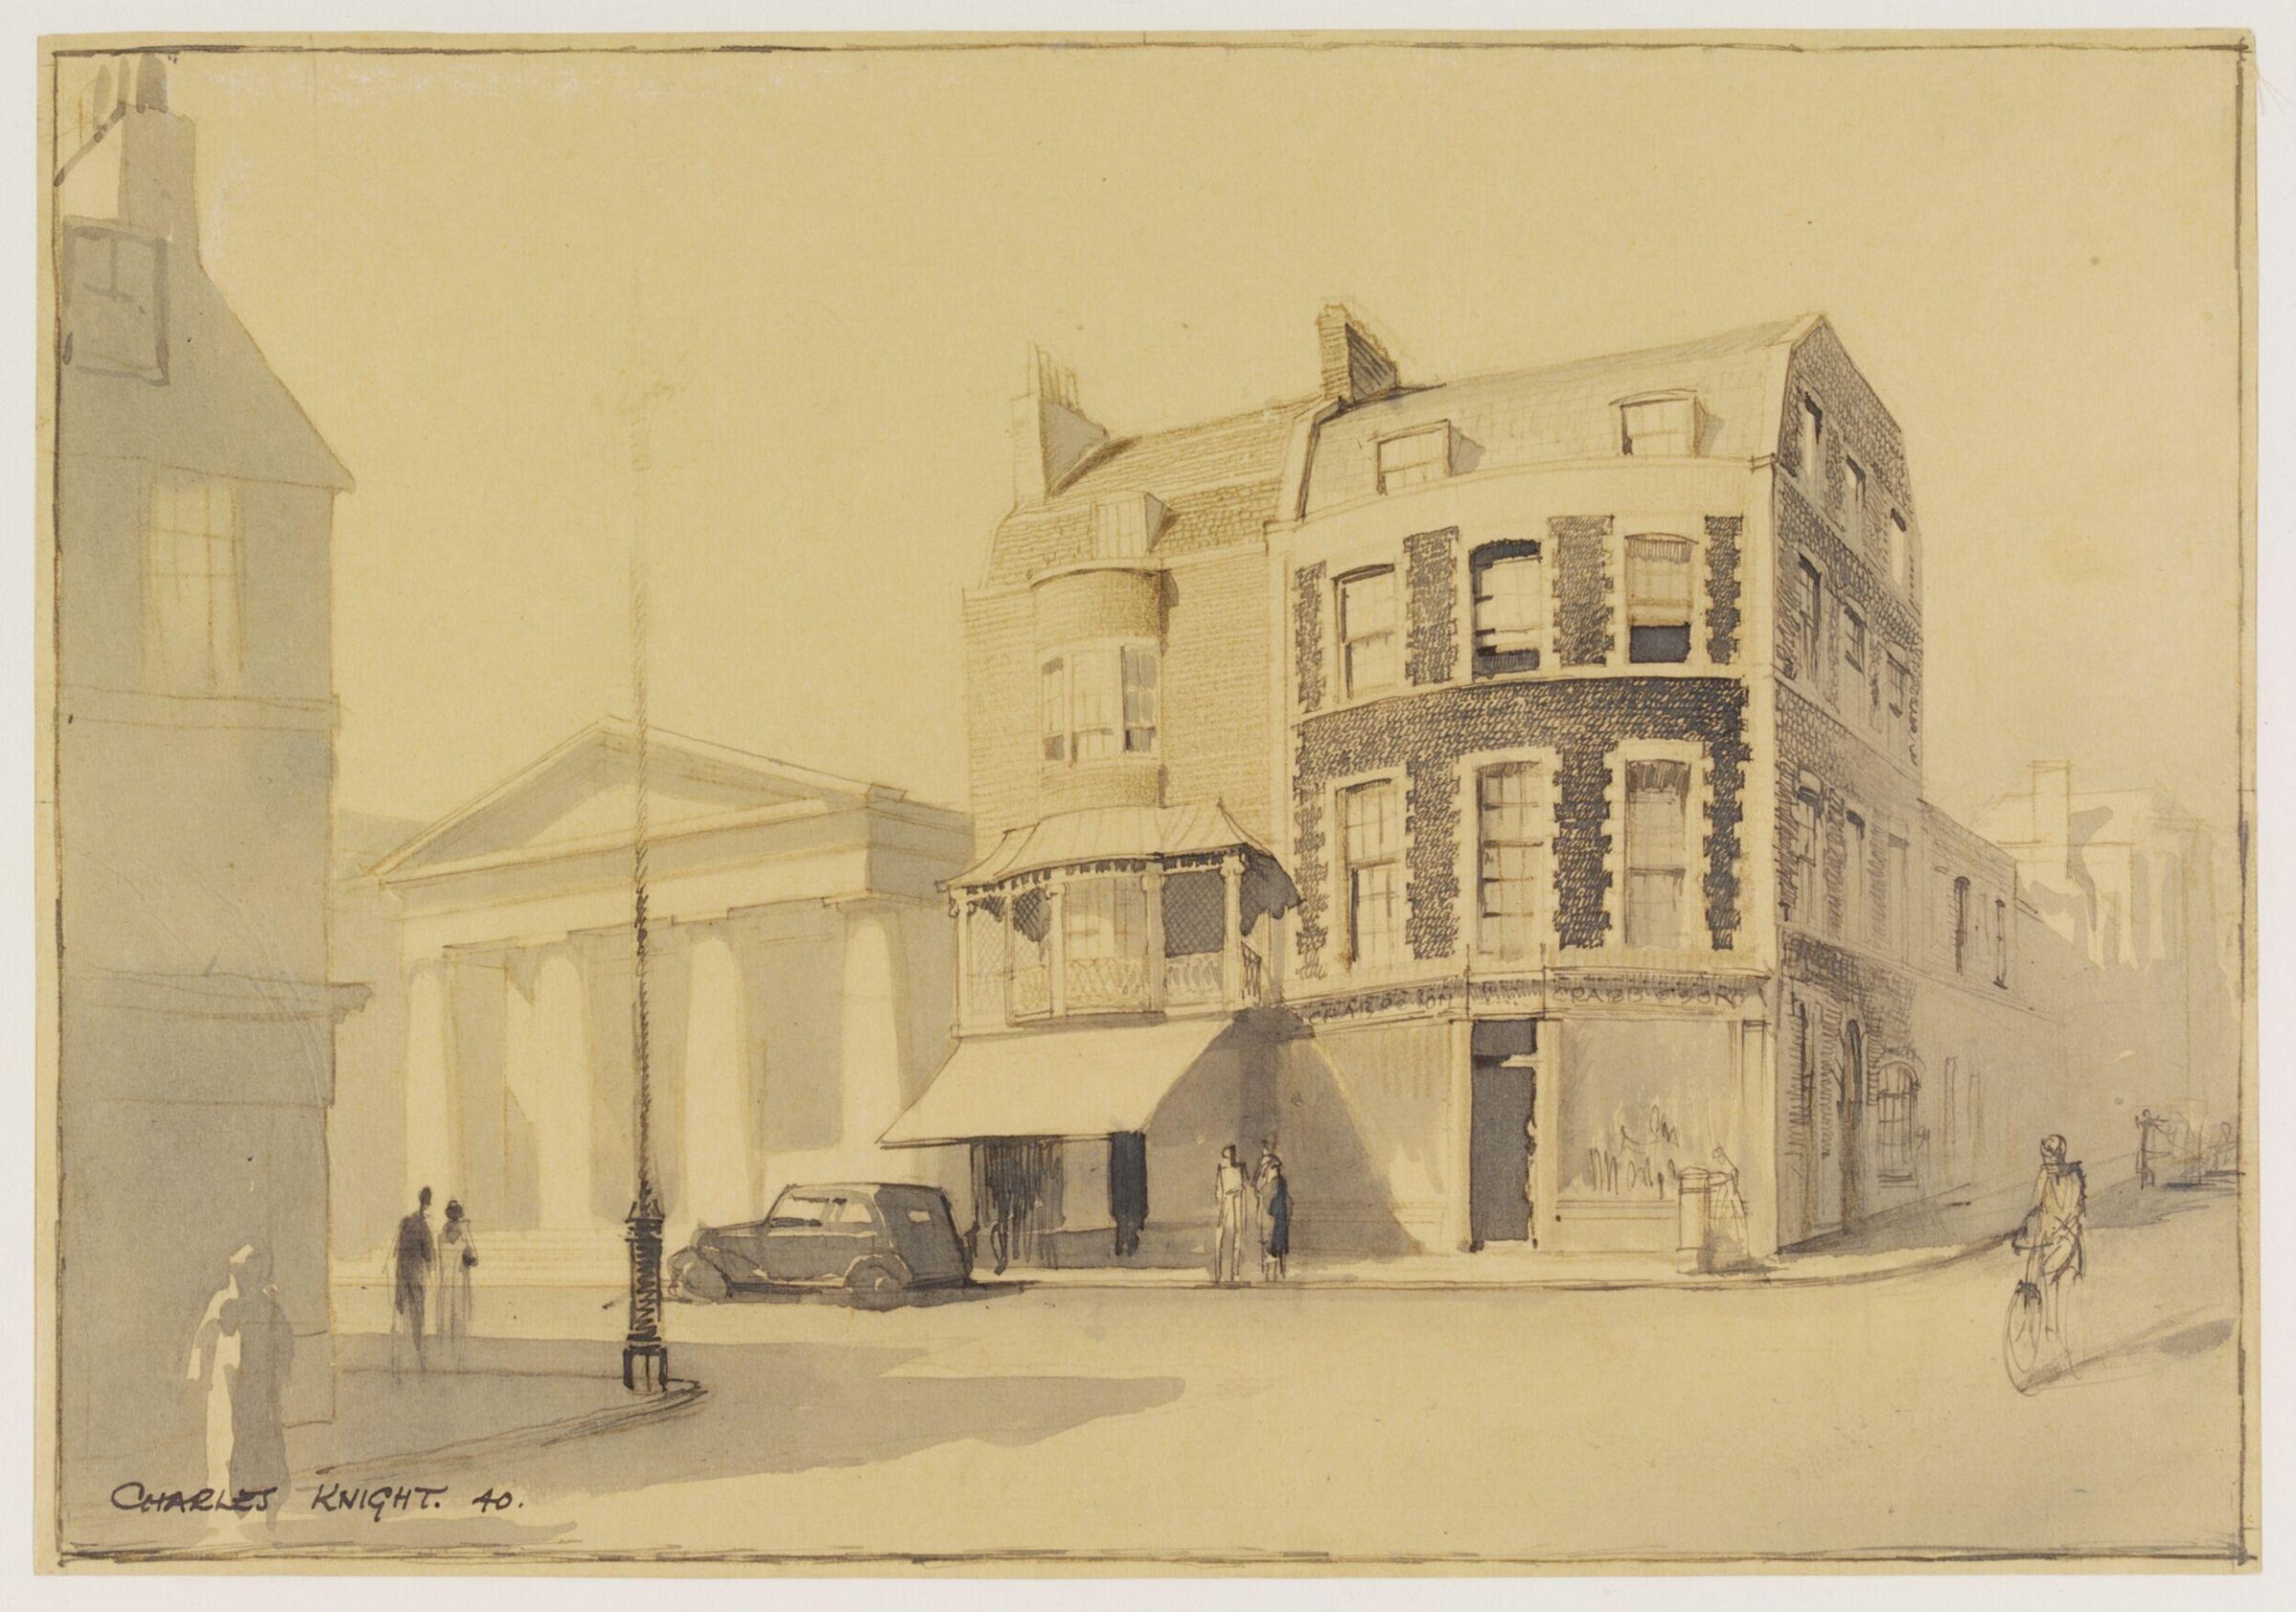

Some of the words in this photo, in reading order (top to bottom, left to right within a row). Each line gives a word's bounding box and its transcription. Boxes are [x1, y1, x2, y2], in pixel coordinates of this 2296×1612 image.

[111, 1482, 278, 1513] CHARLES
[311, 1483, 446, 1523] KNIGHT.
[472, 1488, 523, 1513] 40.
